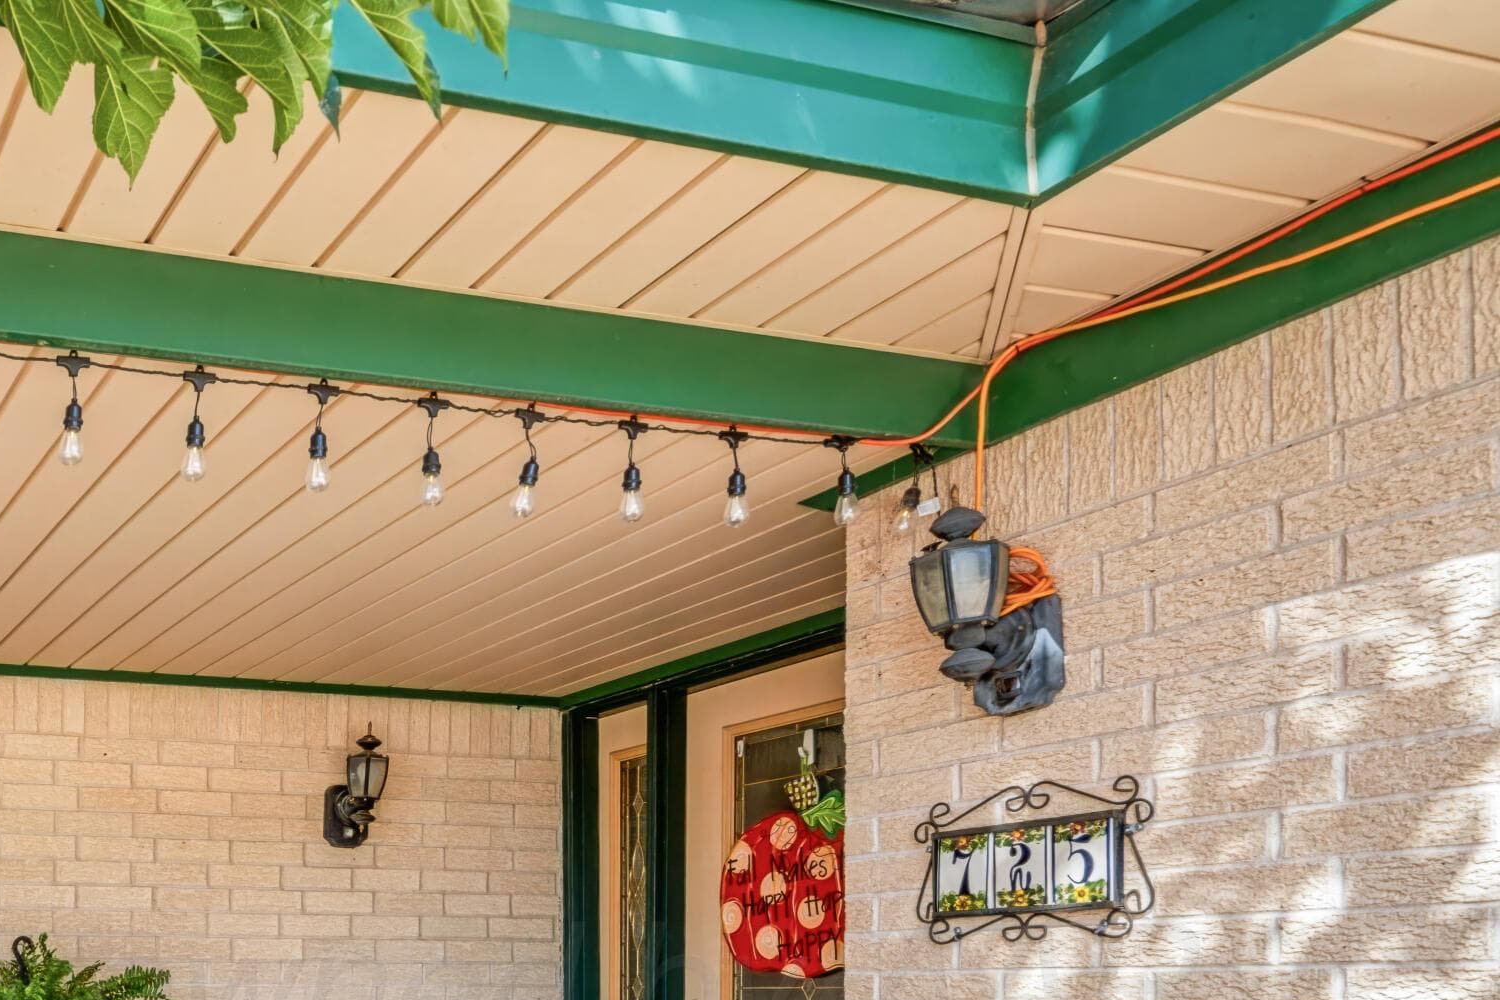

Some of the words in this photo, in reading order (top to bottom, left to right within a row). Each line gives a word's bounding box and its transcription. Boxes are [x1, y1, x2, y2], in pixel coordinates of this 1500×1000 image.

[727, 853, 757, 885] Fall
[770, 847, 828, 883] Makes
[952, 833, 1094, 895] 725
